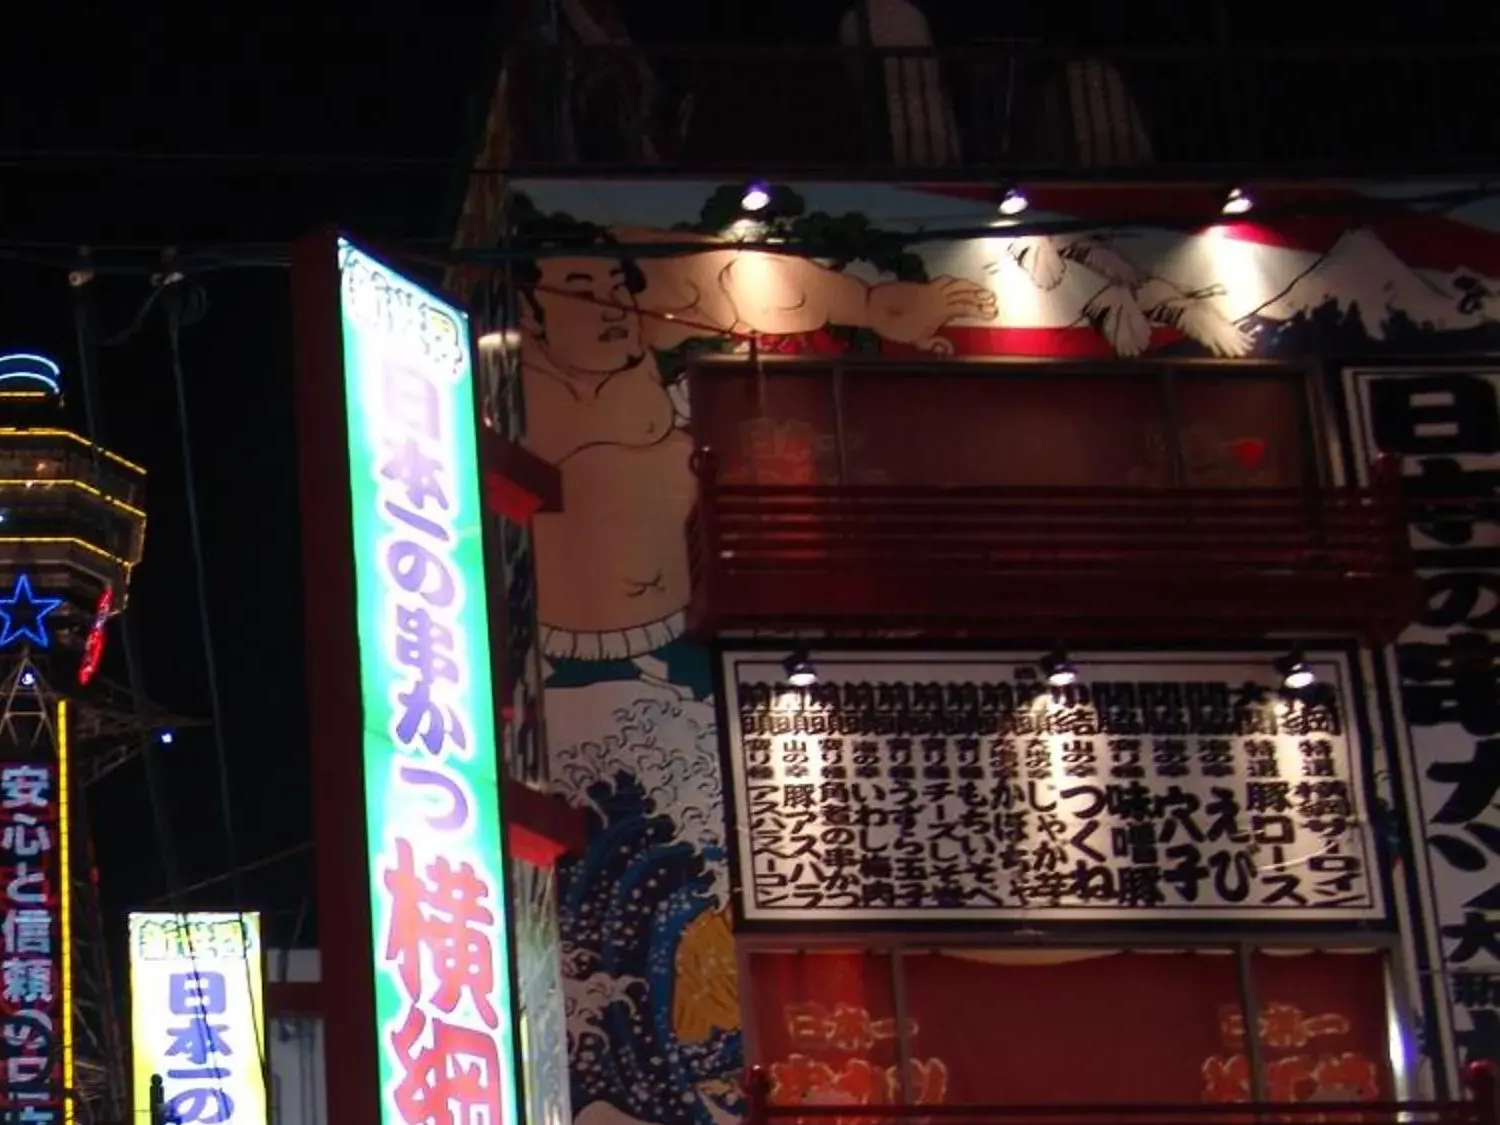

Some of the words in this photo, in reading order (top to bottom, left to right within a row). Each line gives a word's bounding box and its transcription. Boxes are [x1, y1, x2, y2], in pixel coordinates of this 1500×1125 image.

[378, 362, 470, 830] 日本一の串かつ
[1060, 785, 1119, 899] つくね
[1154, 786, 1209, 902] 穴子
[1206, 786, 1257, 902] えび
[1246, 781, 1308, 904] 豚ロース
